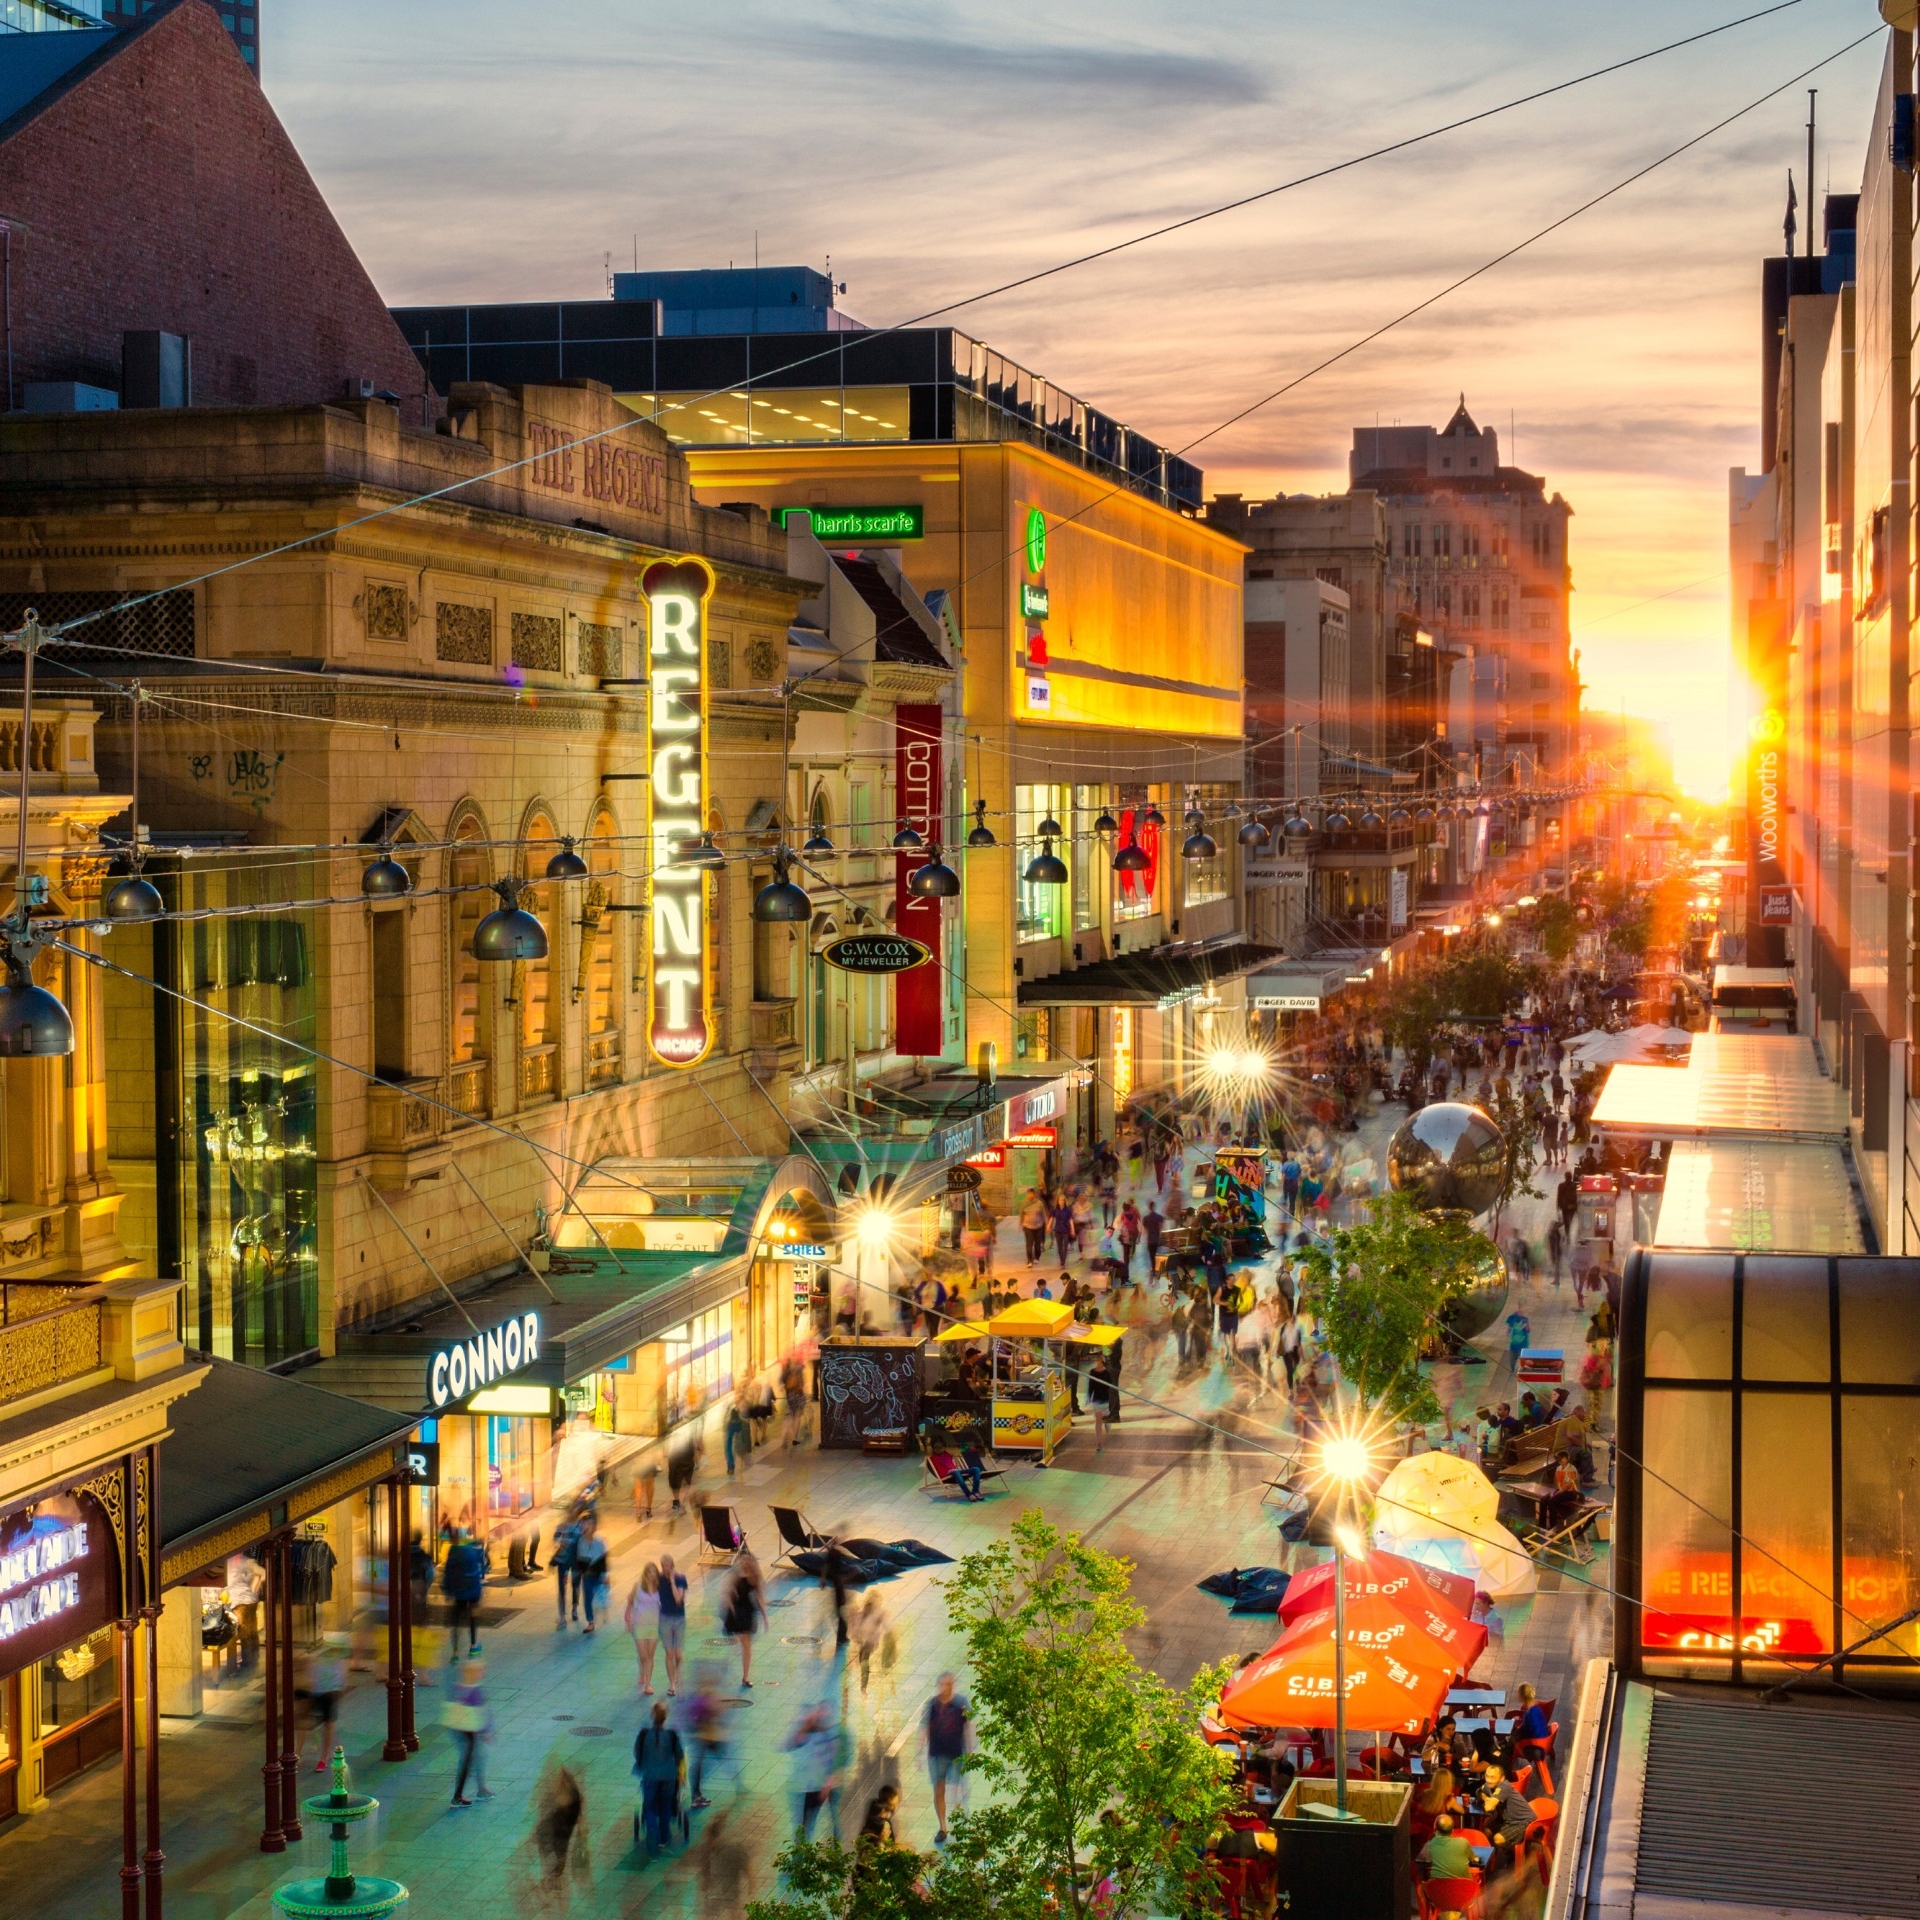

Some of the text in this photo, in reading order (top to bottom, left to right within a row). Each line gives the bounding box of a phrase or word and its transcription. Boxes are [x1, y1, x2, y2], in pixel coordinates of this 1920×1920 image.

[529, 423, 664, 515] THE REGENT
[815, 511, 913, 533] harris scarfe
[650, 594, 700, 1030] REGENT
[1756, 751, 1778, 862] Woolworths
[1247, 870, 1303, 878] ROGER DAVID
[1768, 895, 1787, 906] Just
[1764, 903, 1790, 917] Jeans
[874, 942, 910, 956] COX
[842, 957, 909, 966] MY JEWELLER
[655, 1038, 702, 1053] ARCADE
[432, 1312, 539, 1407] CONNOR
